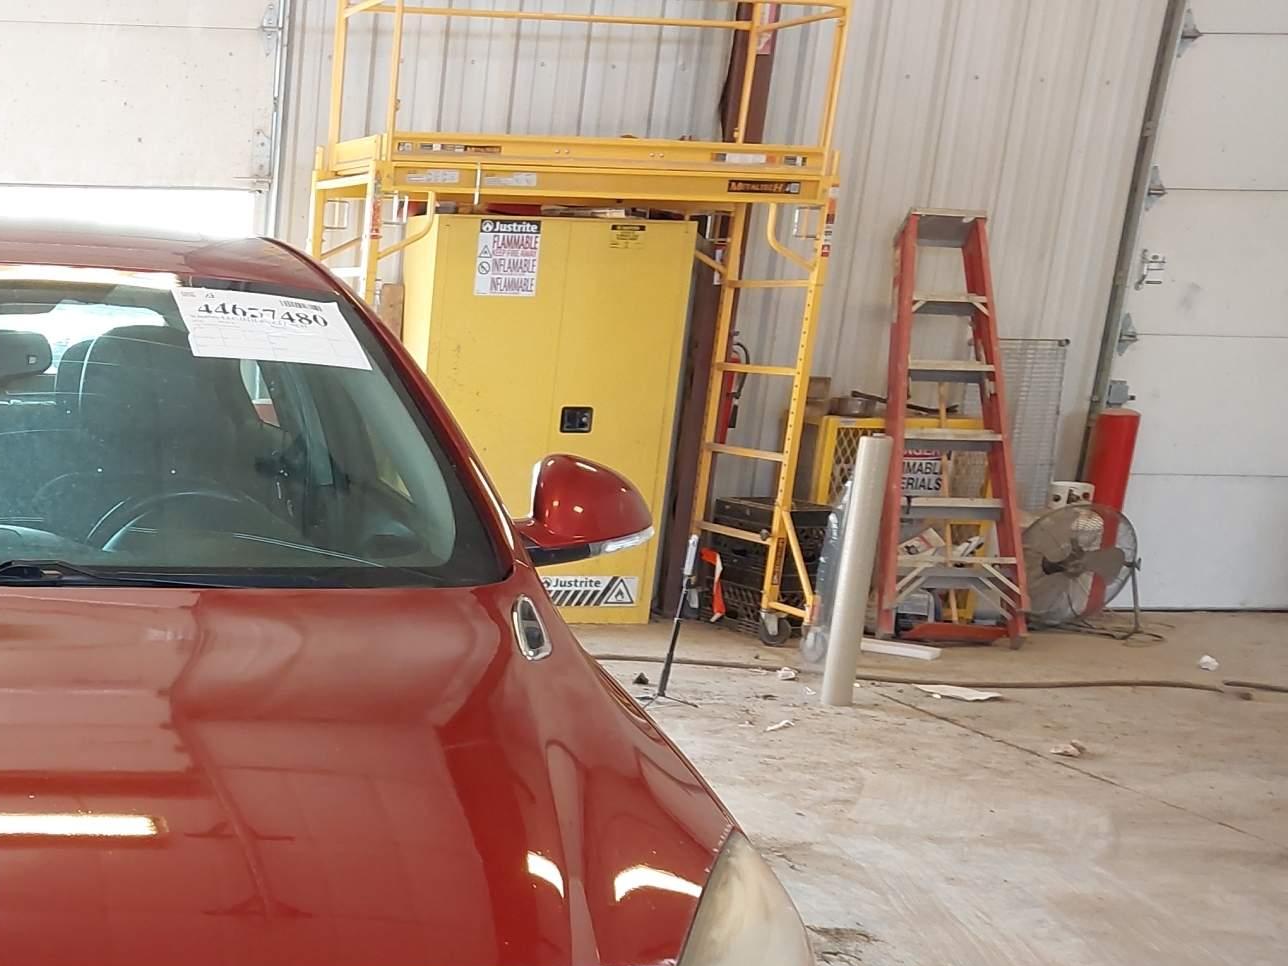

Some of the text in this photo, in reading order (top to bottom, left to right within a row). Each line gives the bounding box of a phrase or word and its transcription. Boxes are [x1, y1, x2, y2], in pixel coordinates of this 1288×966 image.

[493, 221, 538, 233] Justrite
[492, 234, 539, 250] FLAMMABLE
[553, 577, 601, 588] Justrite
